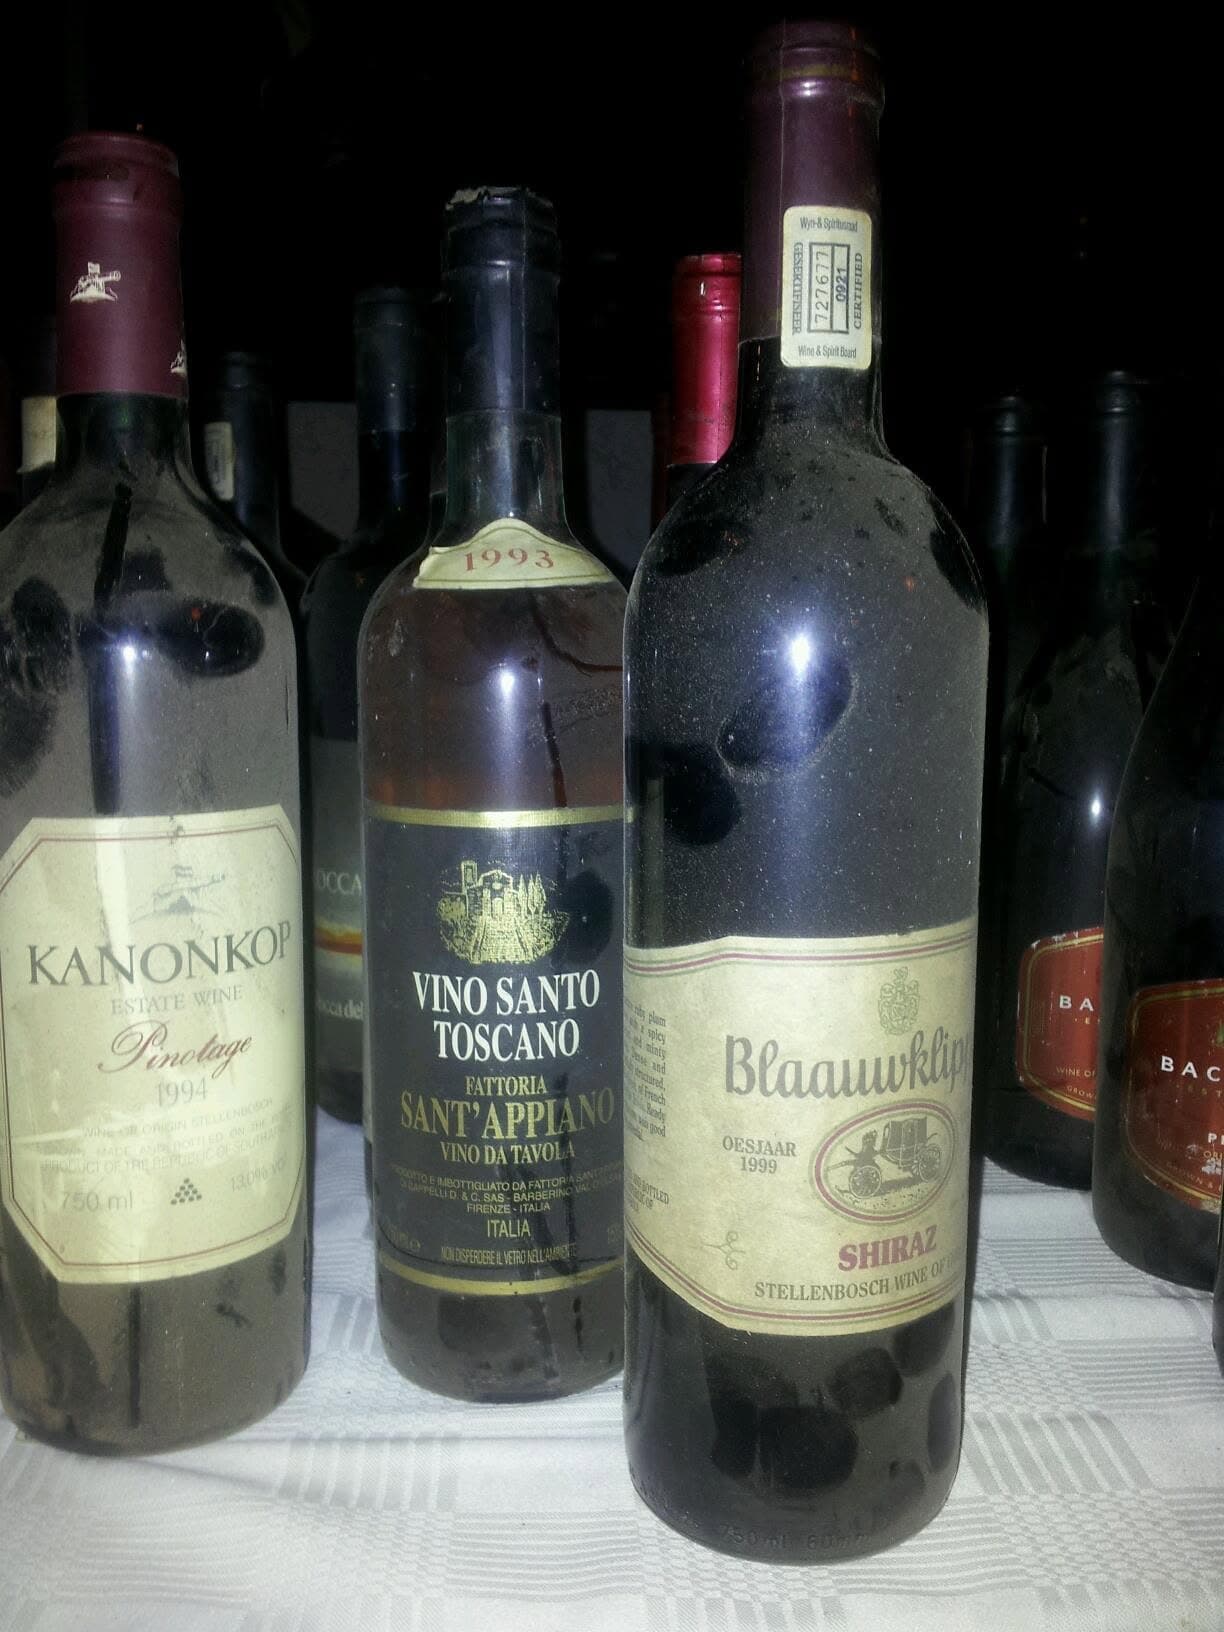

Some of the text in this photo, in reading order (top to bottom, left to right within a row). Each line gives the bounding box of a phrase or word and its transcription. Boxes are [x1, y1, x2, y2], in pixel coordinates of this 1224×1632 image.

[814, 250, 829, 325] 727677
[835, 267, 848, 302] 0921
[853, 252, 863, 330] CERTIFIED
[798, 345, 857, 360] Wine & Spirit Board
[463, 547, 555, 572] 1993
[28, 920, 291, 986] KANONKOP
[111, 984, 243, 1015] ESTATE WINE
[412, 969, 600, 1016] VINO SANTO
[1059, 995, 1094, 1012] BA
[648, 1010, 666, 1027] plum
[433, 1018, 580, 1062] TOSCANO
[647, 1029, 666, 1046] spicy
[97, 1019, 253, 1080] Pinotage
[652, 1062, 666, 1075] and
[725, 1025, 972, 1099] Blaauwklip
[1055, 1065, 1081, 1078] WINE
[1161, 1055, 1221, 1083] BAC
[157, 1076, 208, 1108] 1994
[465, 1075, 547, 1097] FATTORIA
[644, 1085, 666, 1106] French
[400, 1088, 615, 1140] SANT'APPIANO
[649, 1122, 666, 1138] good
[440, 1140, 576, 1165] VINO DA TAVOLA
[722, 1135, 797, 1157] OESJAAR
[740, 1156, 778, 1175] 1999
[437, 1176, 509, 1192] IMBOTTIGLIATO
[511, 1178, 527, 1191] DA
[528, 1175, 575, 1190] FATTORIA
[61, 1190, 134, 1212] 750 ml
[461, 1191, 469, 1201] &
[471, 1193, 480, 1203] C.
[484, 1194, 505, 1203] SAS
[513, 1187, 572, 1202] BARBERINO
[466, 1203, 510, 1214] FIRENZE
[519, 1202, 551, 1214] ITALIA
[486, 1219, 532, 1238] ITALIA
[504, 1249, 526, 1265] VETRO
[837, 1224, 938, 1272] SHIRAZ
[754, 1277, 890, 1301] STELLENBOSCH
[894, 1265, 929, 1290] WINE
[930, 1259, 947, 1278] OF
